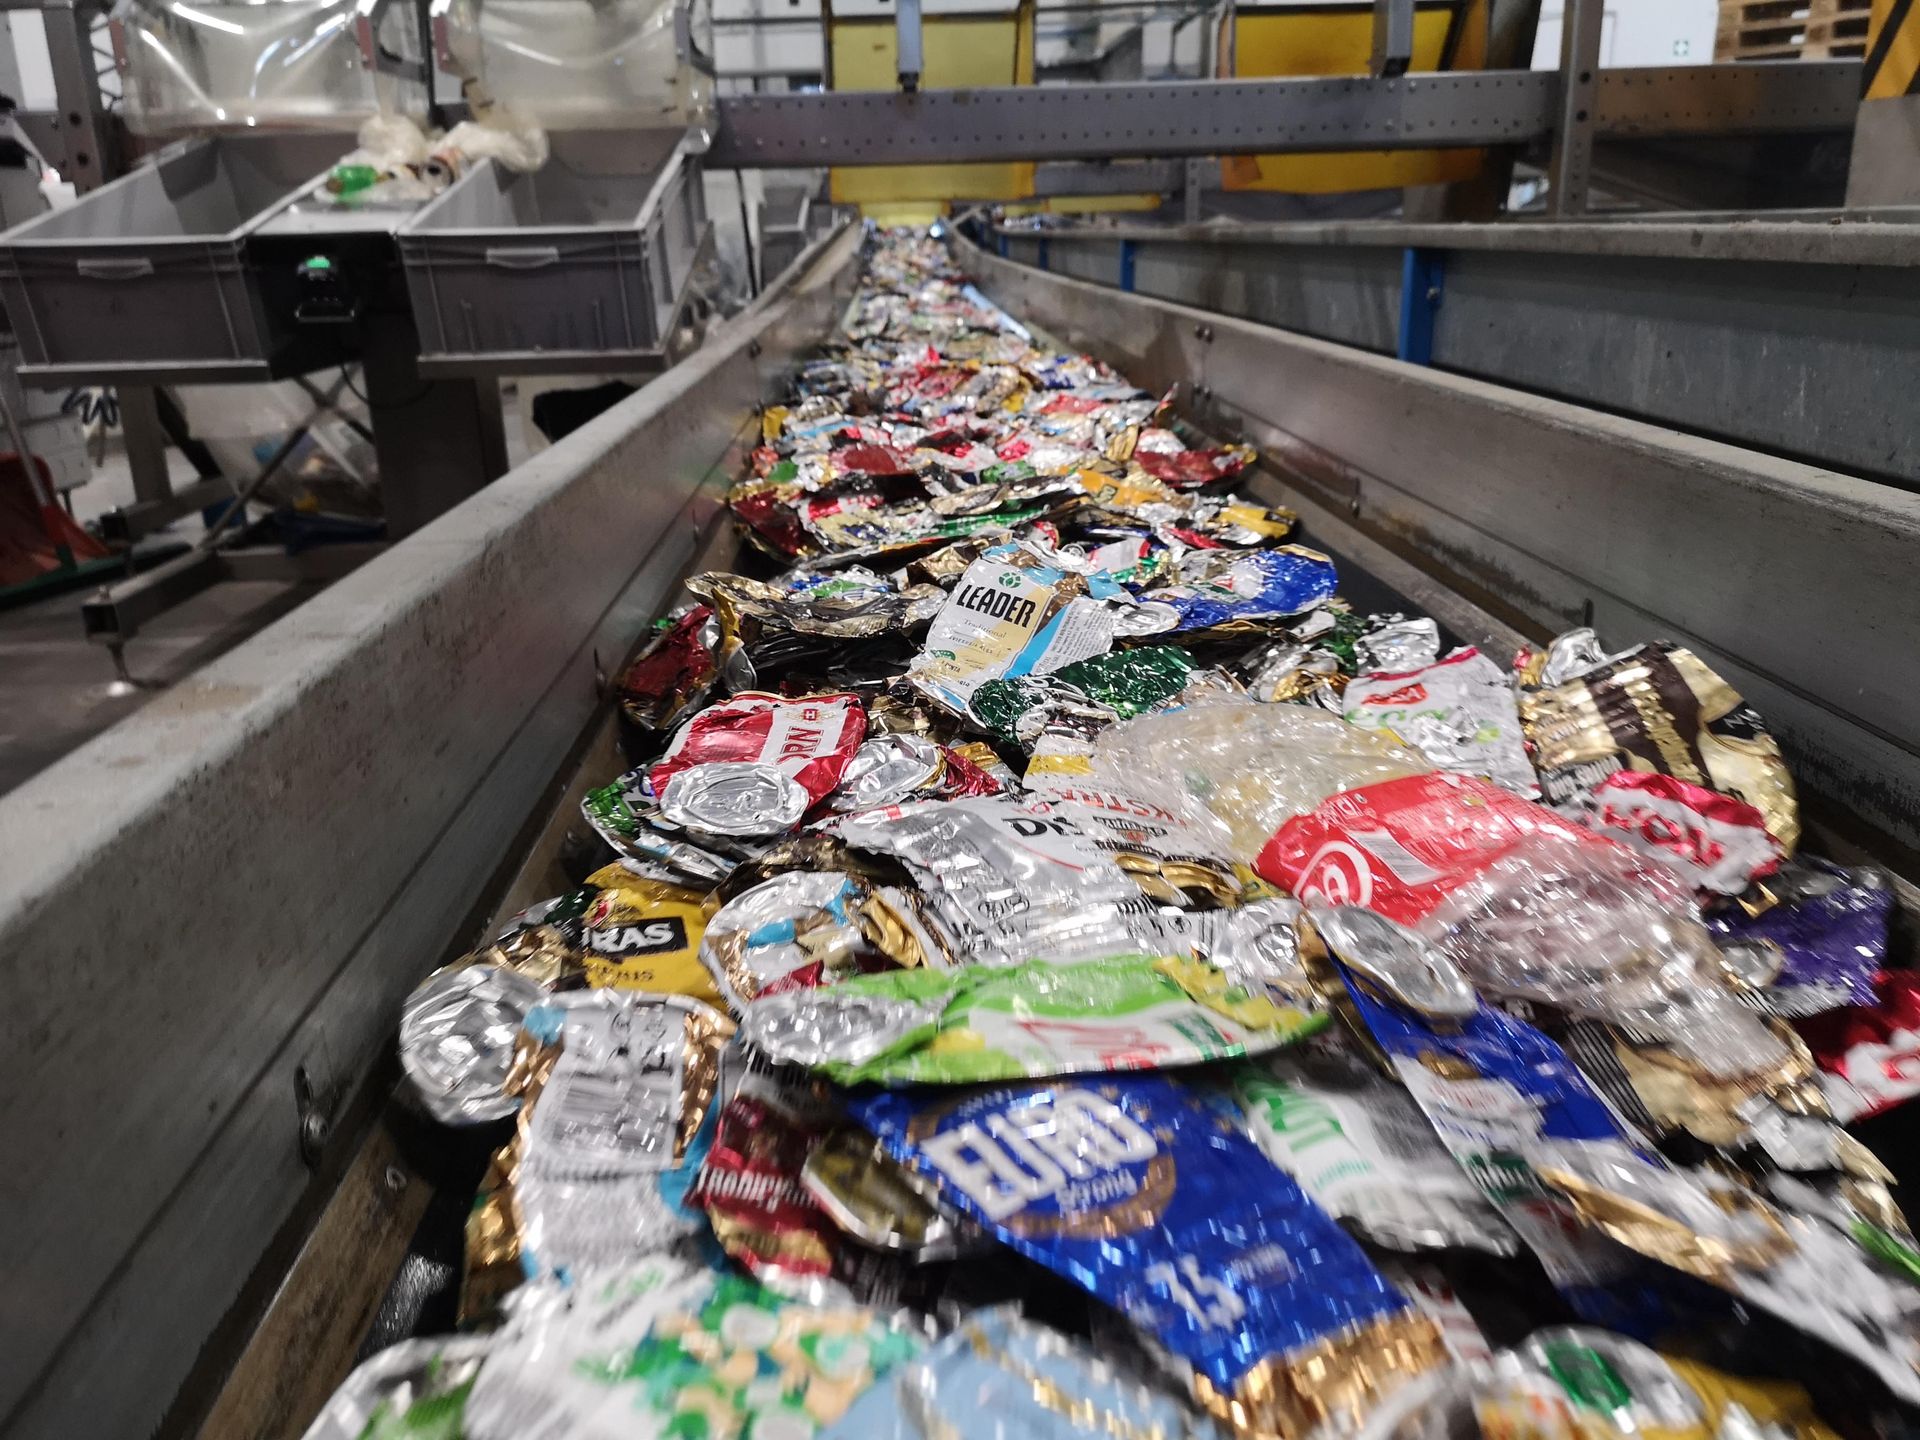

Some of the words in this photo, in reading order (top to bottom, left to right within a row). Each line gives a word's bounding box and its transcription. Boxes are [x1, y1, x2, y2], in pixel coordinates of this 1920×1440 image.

[956, 584, 1037, 629] LEADER
[963, 619, 1007, 639] Traditional
[919, 1089, 1158, 1222] EURO
